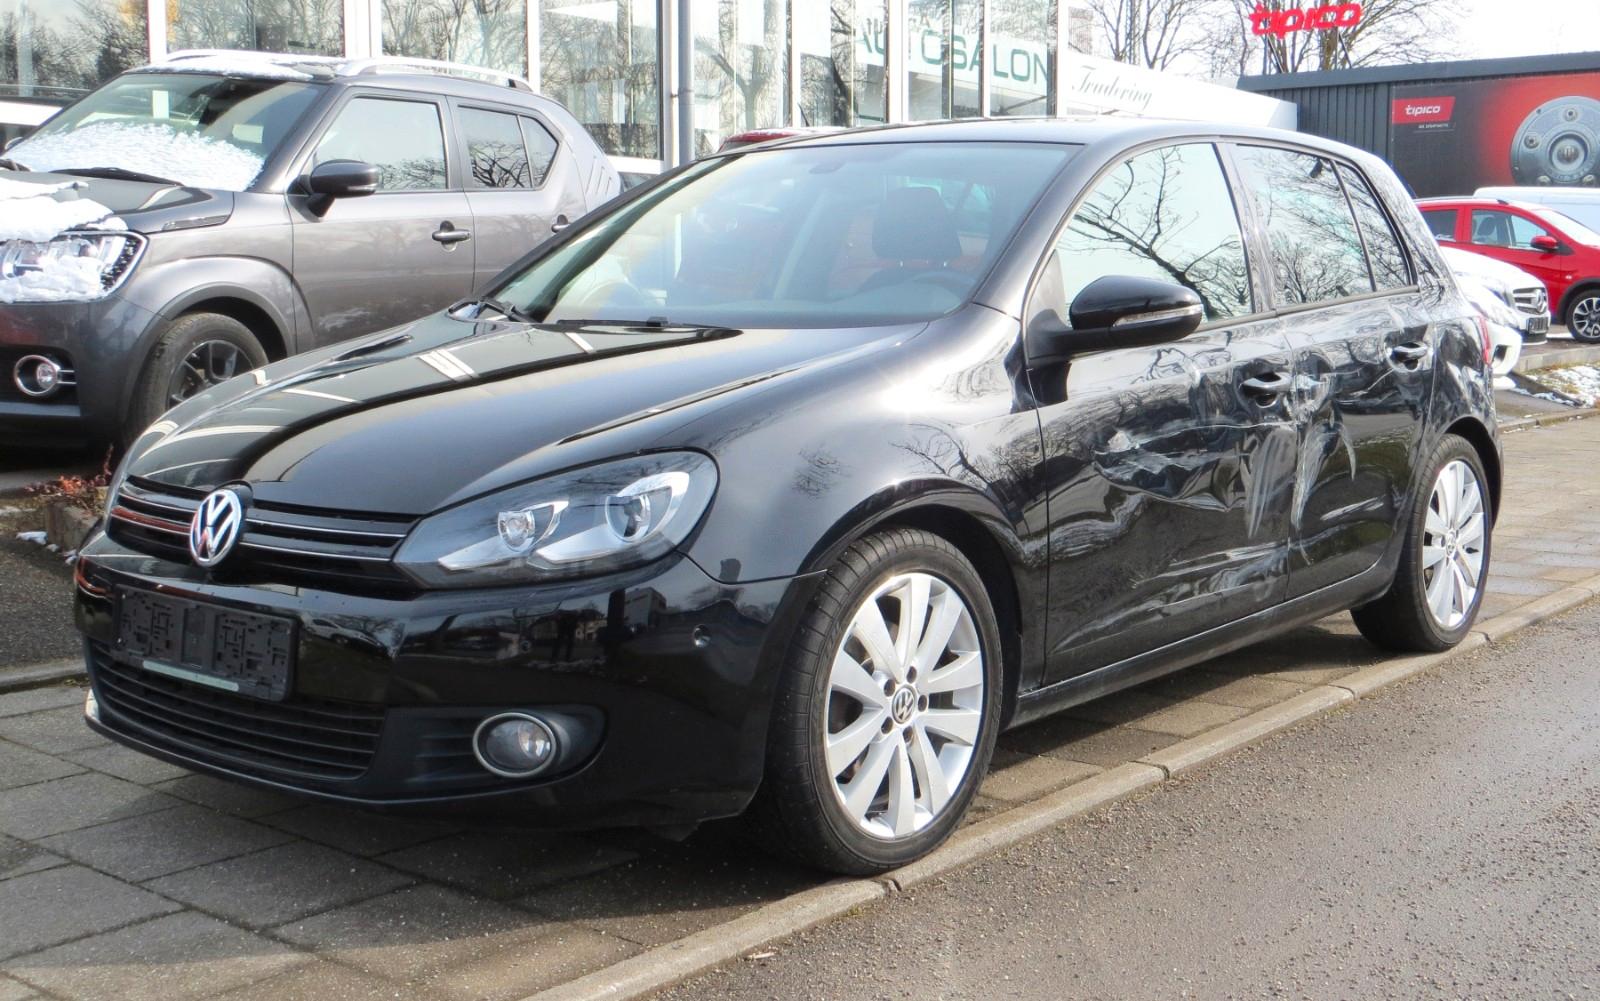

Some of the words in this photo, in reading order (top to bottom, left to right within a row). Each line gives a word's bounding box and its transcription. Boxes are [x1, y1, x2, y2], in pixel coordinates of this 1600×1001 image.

[1249, 3, 1361, 39] tipico
[857, 20, 1048, 84] AUOSALON
[1405, 105, 1441, 117] tipico
